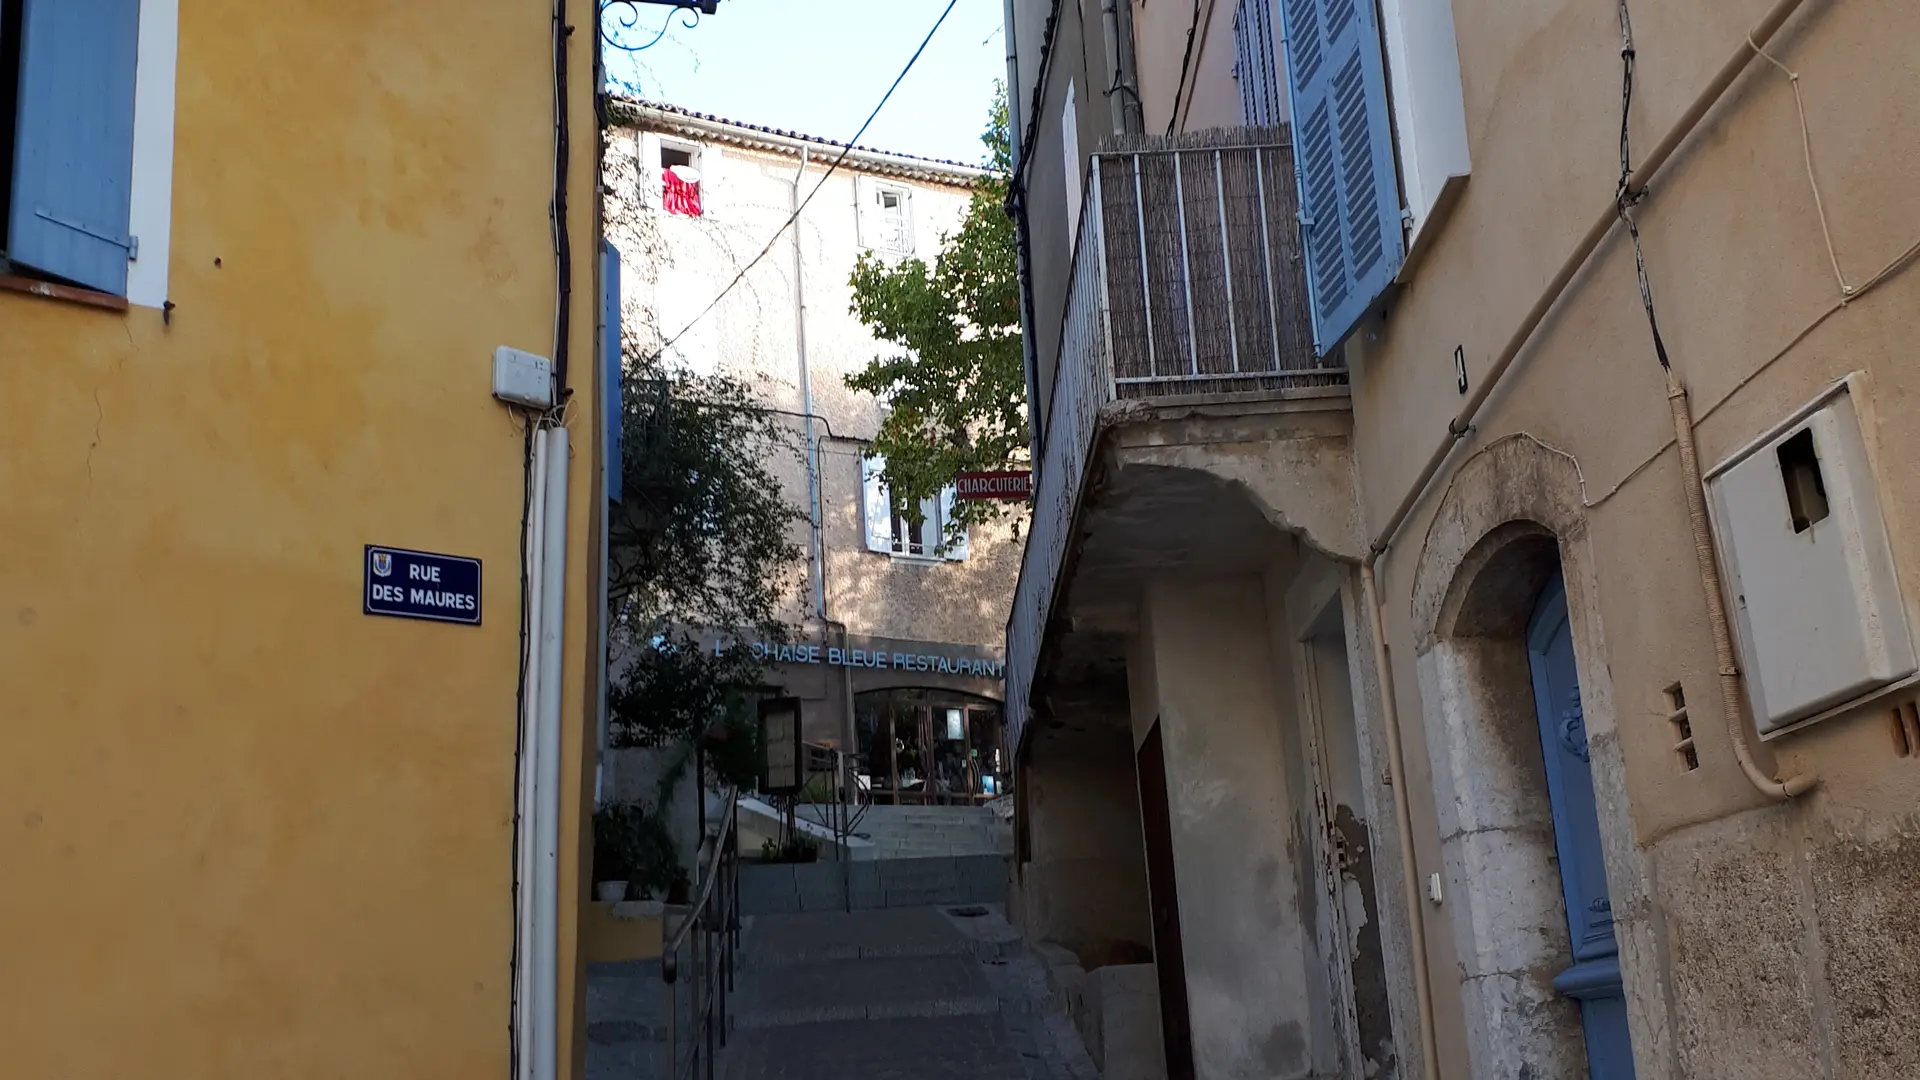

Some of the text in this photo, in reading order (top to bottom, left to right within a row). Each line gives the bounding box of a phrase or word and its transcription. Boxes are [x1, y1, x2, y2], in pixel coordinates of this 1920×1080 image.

[957, 476, 1030, 493] CHARCUTERIE
[409, 563, 441, 582] RUE
[372, 584, 475, 610] DES MAURES
[751, 642, 820, 663] CHAISE
[828, 648, 887, 668] BLEUE
[893, 653, 1005, 677] RESTAURANT
